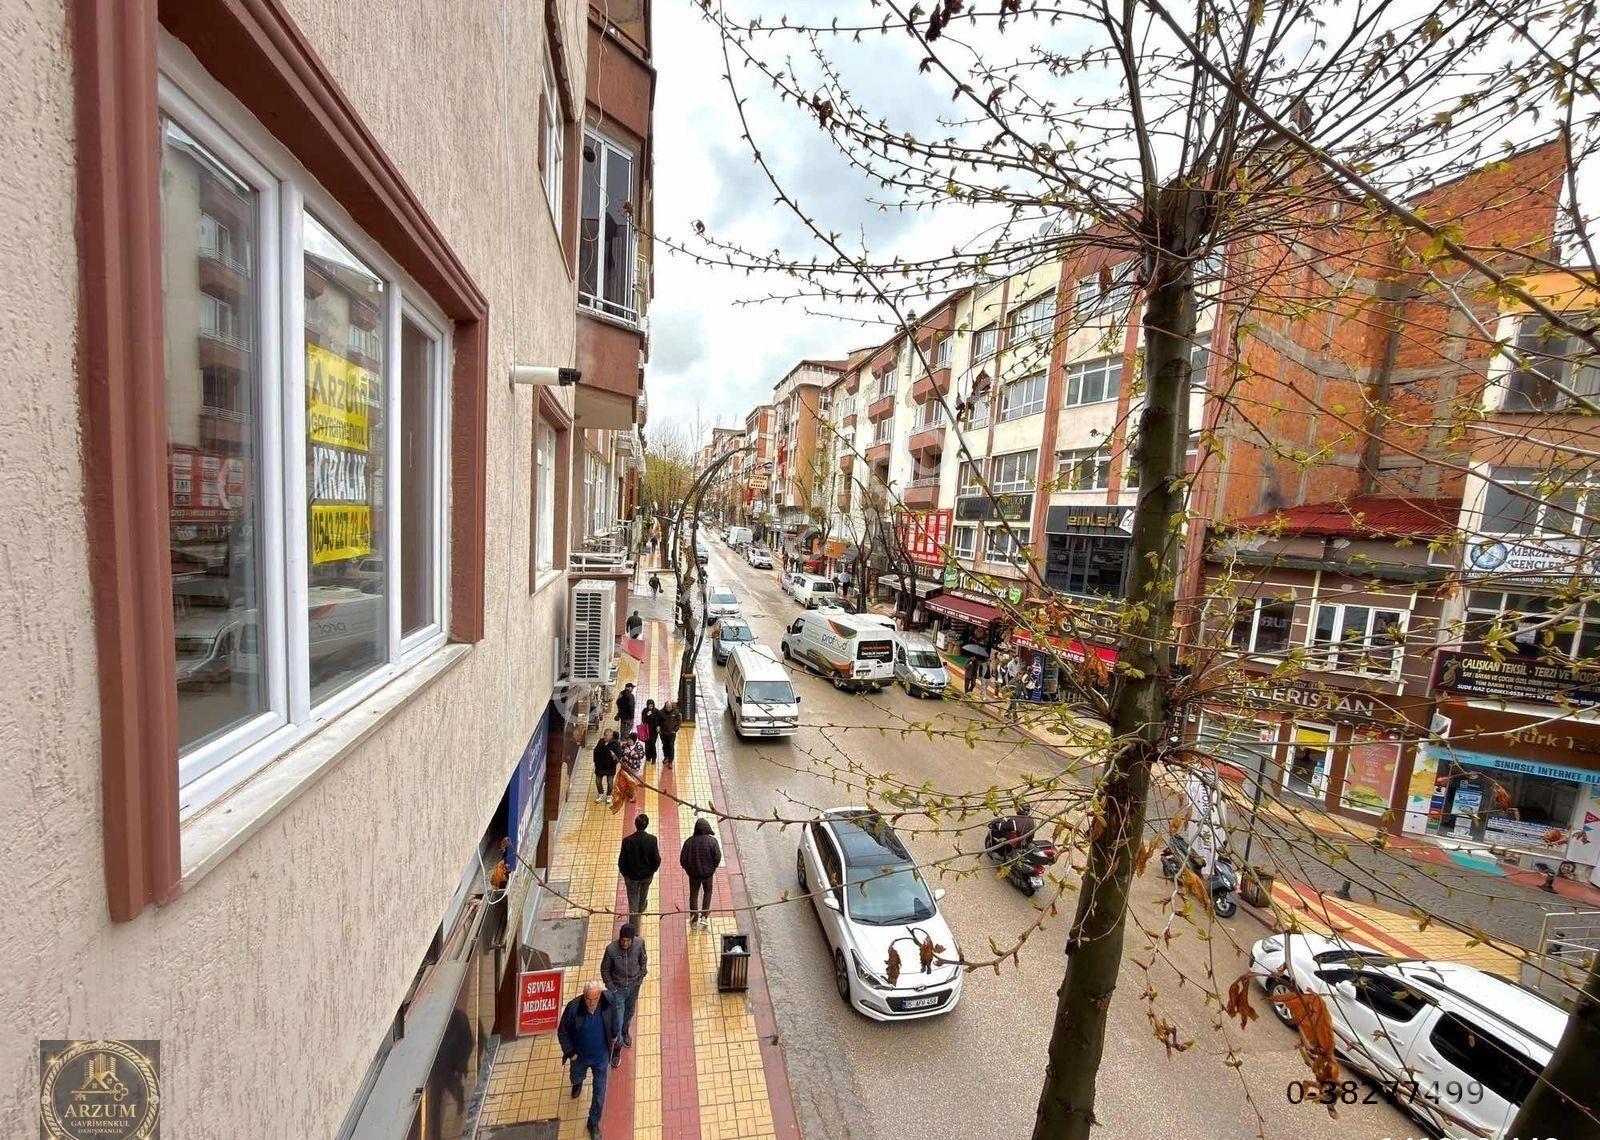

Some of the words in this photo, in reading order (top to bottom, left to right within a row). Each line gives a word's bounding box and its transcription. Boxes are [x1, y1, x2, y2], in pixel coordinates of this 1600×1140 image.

[1494, 759, 1535, 773] SINIRSIZ
[527, 980, 555, 997] ŞEVVAL
[523, 997, 556, 1013] MEDİKAL
